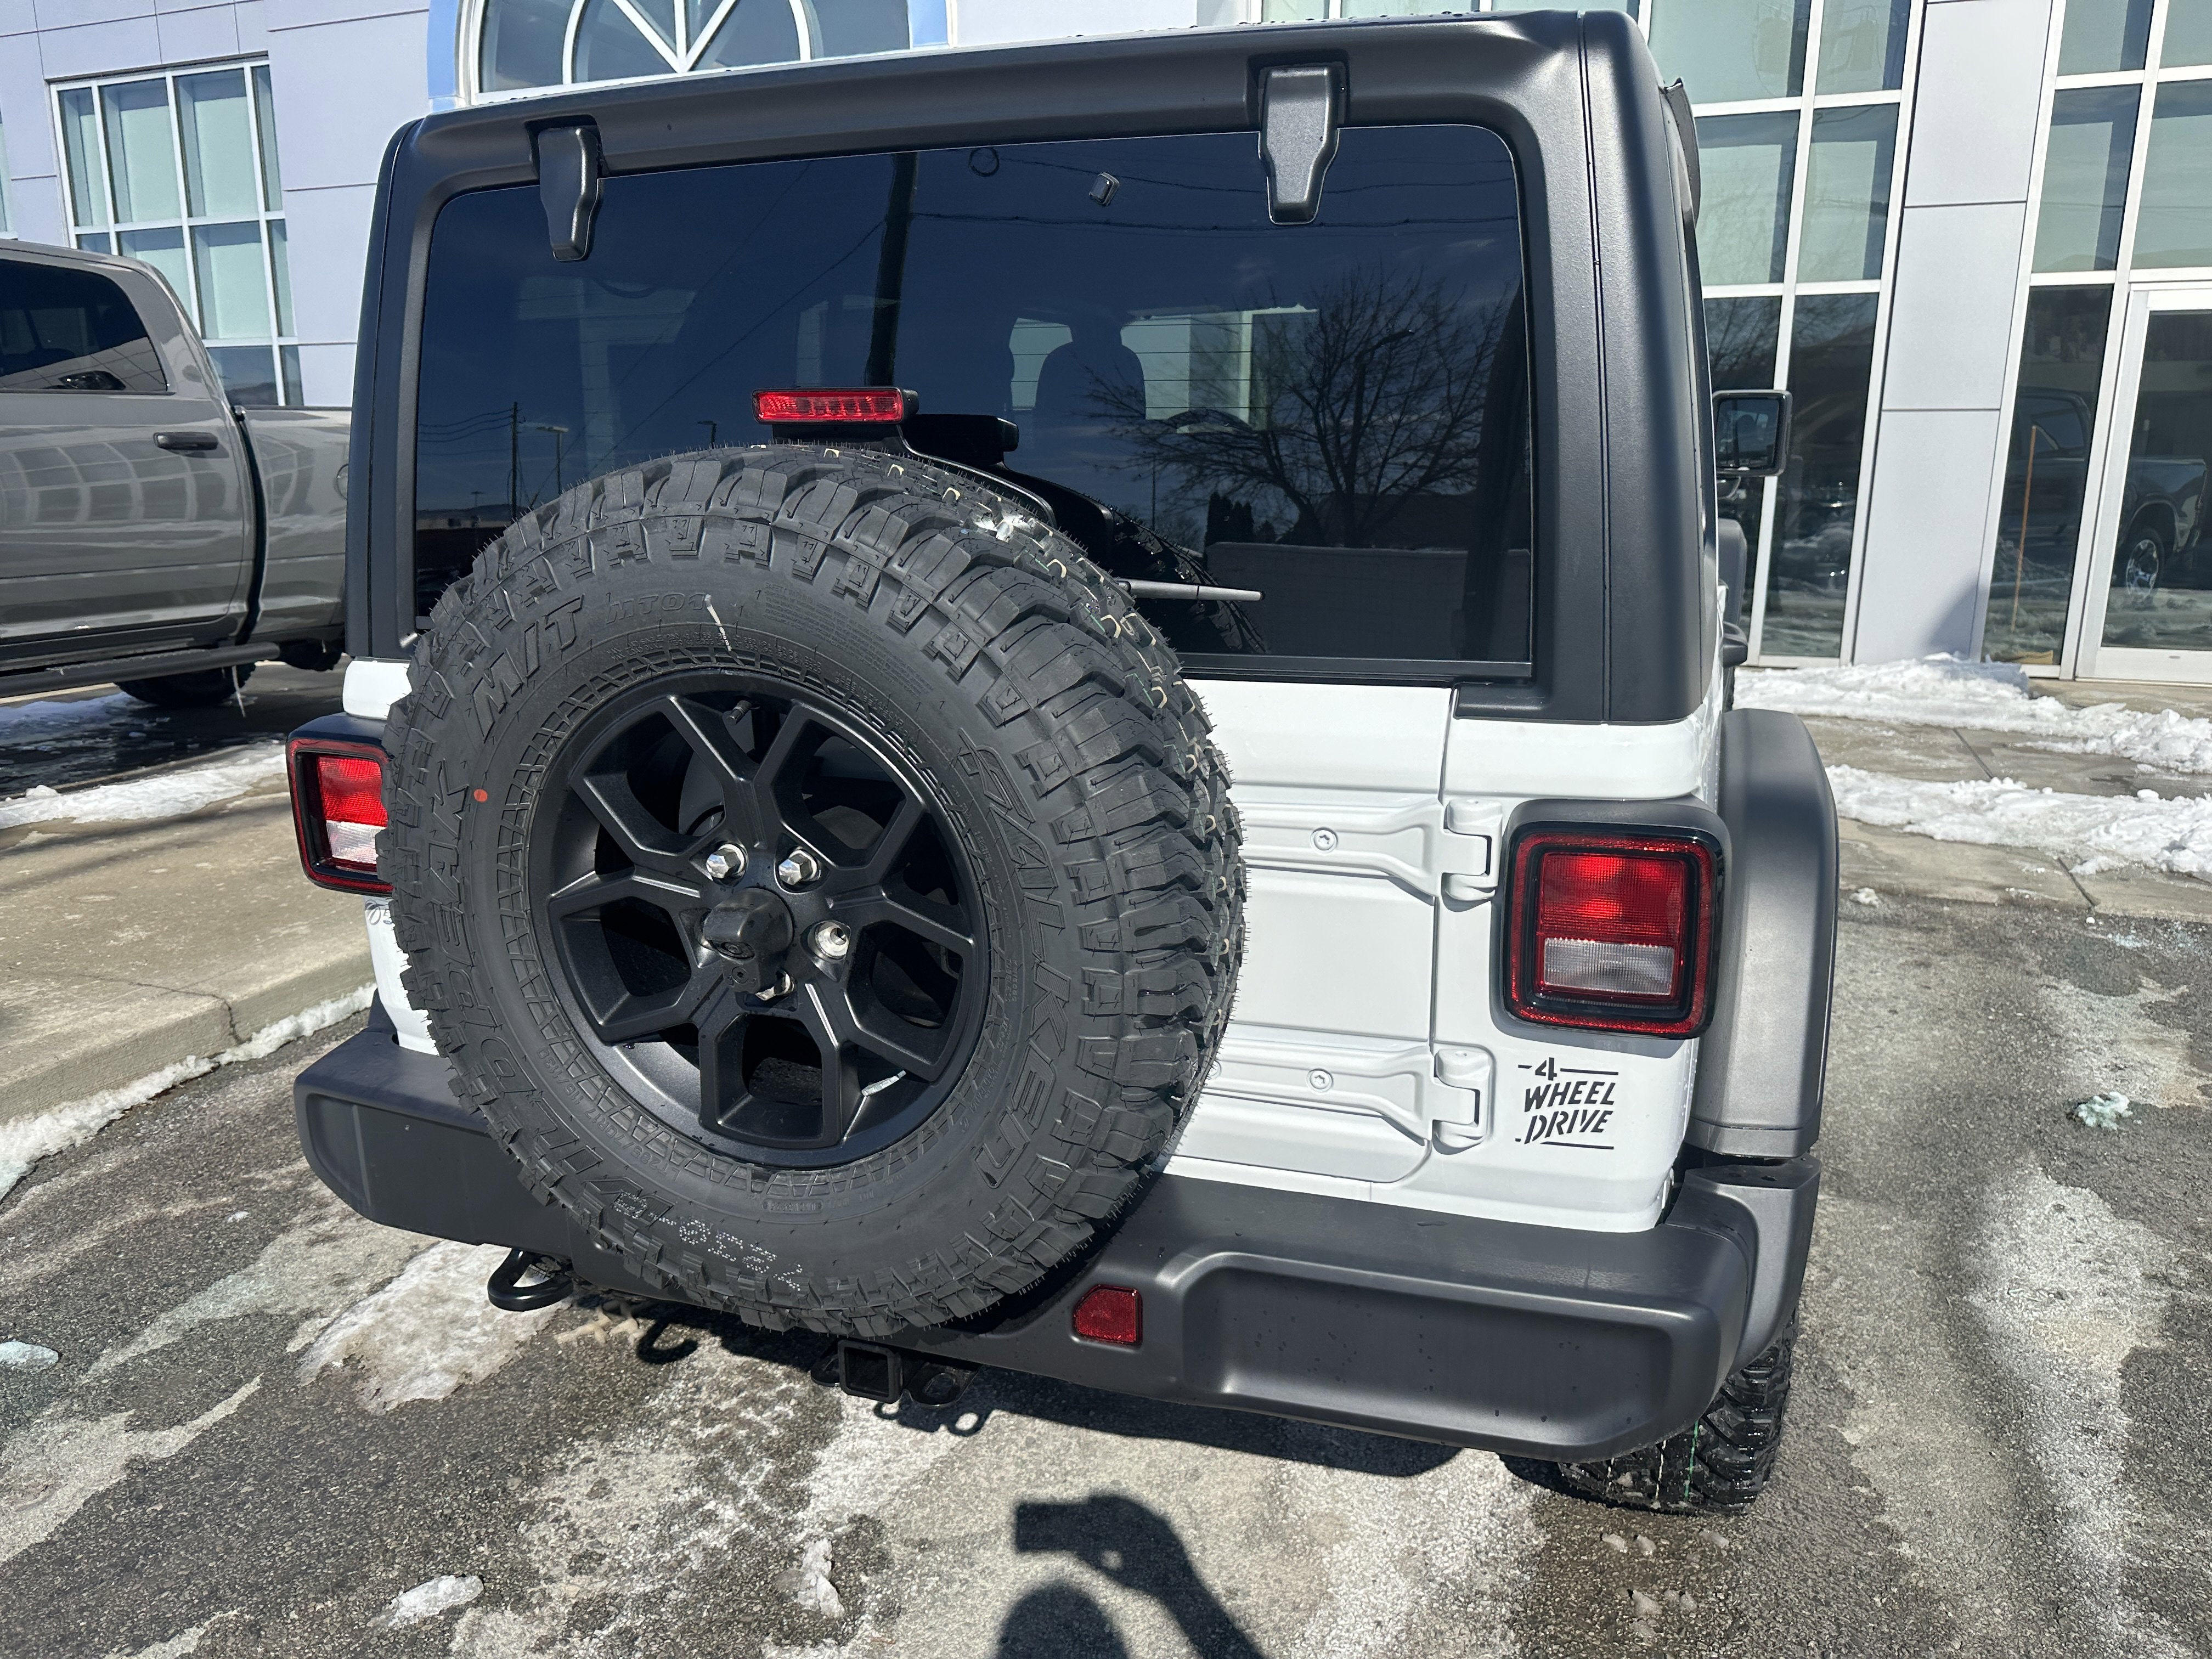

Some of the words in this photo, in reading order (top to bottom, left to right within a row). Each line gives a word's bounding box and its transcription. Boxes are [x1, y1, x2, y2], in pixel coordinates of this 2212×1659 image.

[606, 592, 707, 624] MT01
[472, 594, 584, 741] M/T
[428, 759, 675, 1227] WILDPEAK
[536, 1046, 584, 1106] 116/113Q
[1525, 1081, 1616, 1112] WHEEL
[583, 1104, 679, 1181] LT285/70R17
[1524, 1110, 1613, 1144] DRIVE
